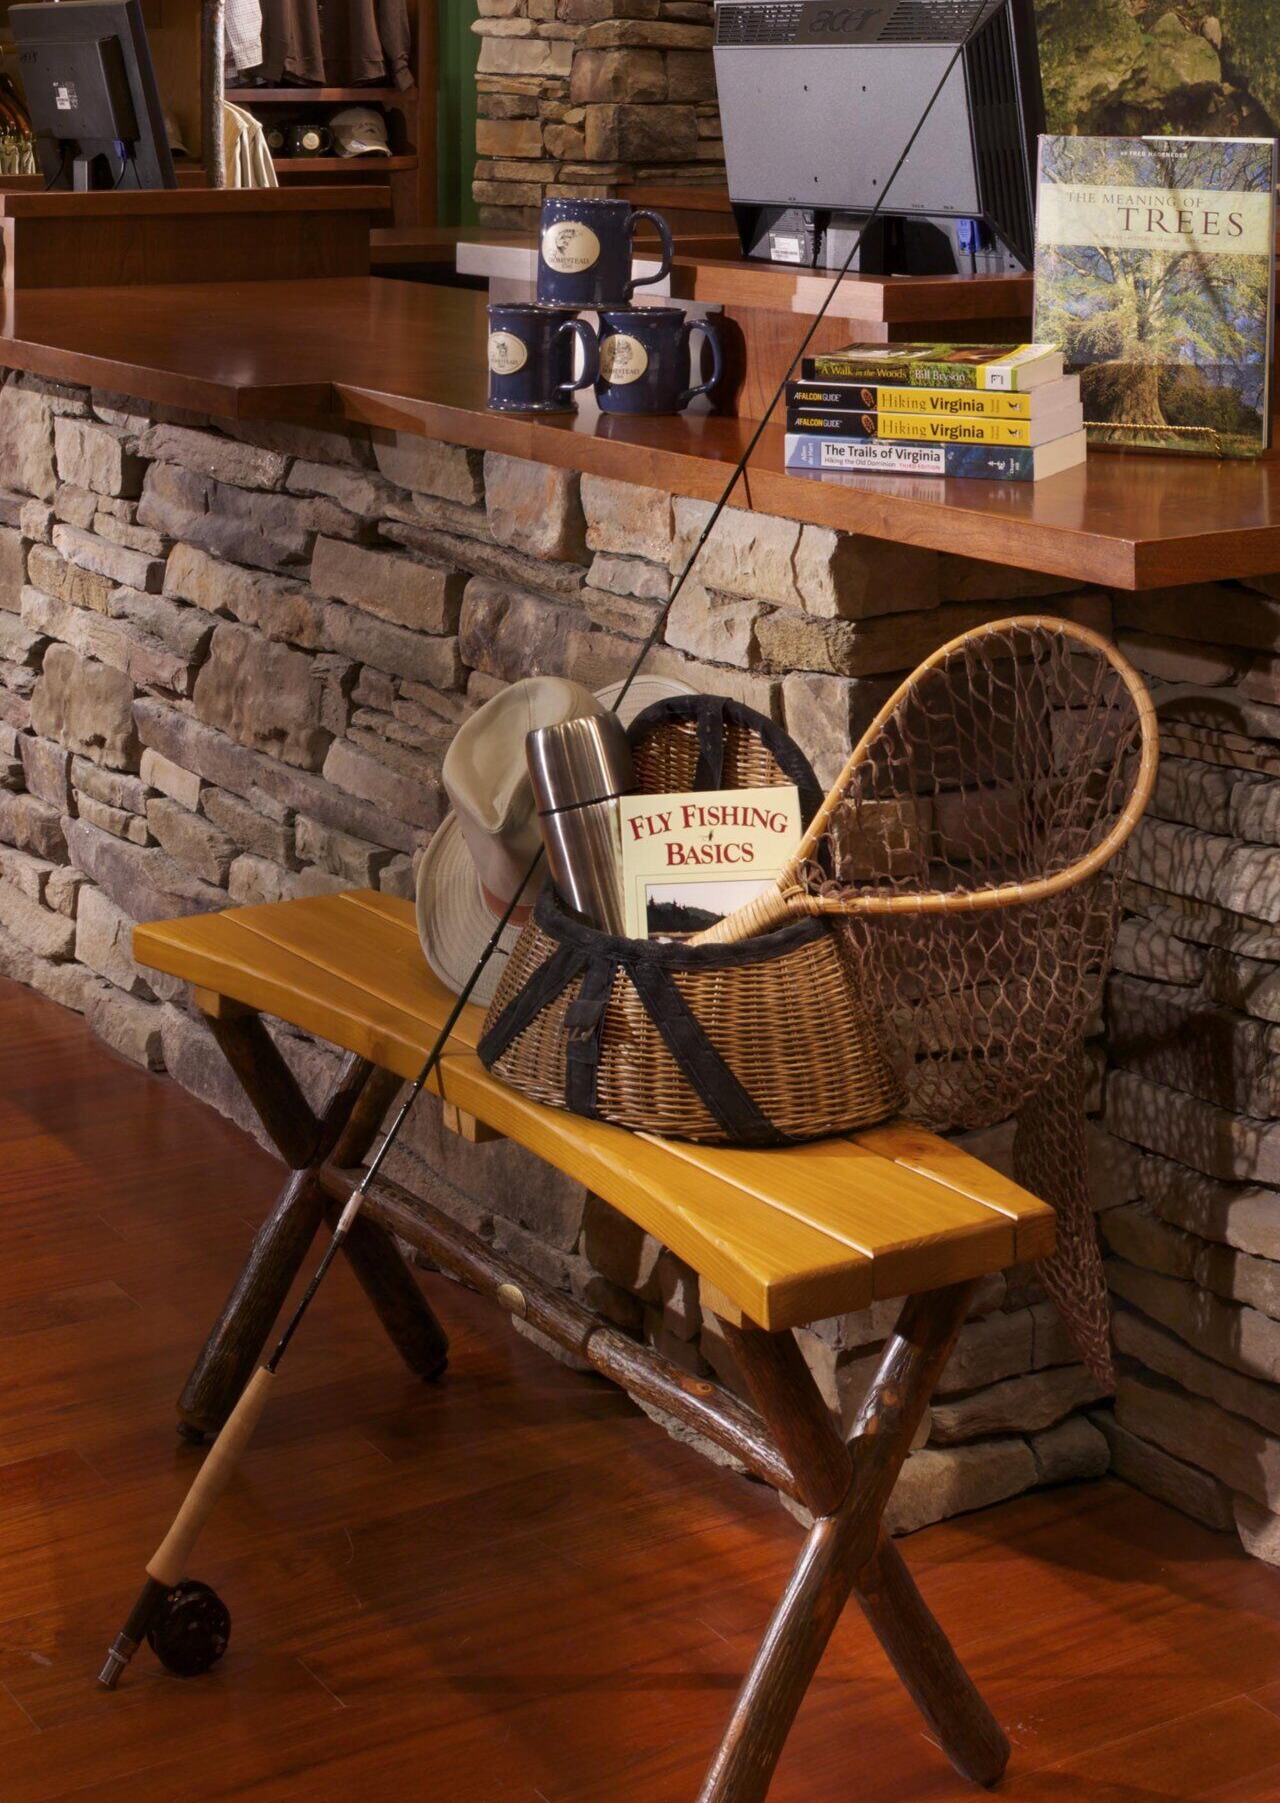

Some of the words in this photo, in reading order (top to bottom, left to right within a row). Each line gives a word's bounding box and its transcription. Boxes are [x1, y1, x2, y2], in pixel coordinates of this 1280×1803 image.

[808, 7, 878, 35] acer
[1066, 192, 1096, 204] THE
[1102, 193, 1176, 208] MEANING
[1183, 196, 1204, 208] OF
[1117, 207, 1244, 237] TREES
[822, 366, 828, 374] A
[831, 365, 853, 375] Walk
[877, 368, 907, 378] Woods
[915, 369, 930, 379] Bill
[933, 370, 965, 381] Bryson
[882, 393, 927, 412] Hiking
[930, 397, 984, 413] Virginia
[883, 419, 927, 437] Hiking
[930, 423, 984, 439] Virginia
[825, 444, 845, 456] The
[848, 445, 877, 458] Trails
[881, 447, 893, 458] of
[895, 449, 940, 464] Virginia
[627, 810, 673, 841] FLY
[681, 803, 789, 834] FISHING
[664, 842, 754, 867] BASICS
